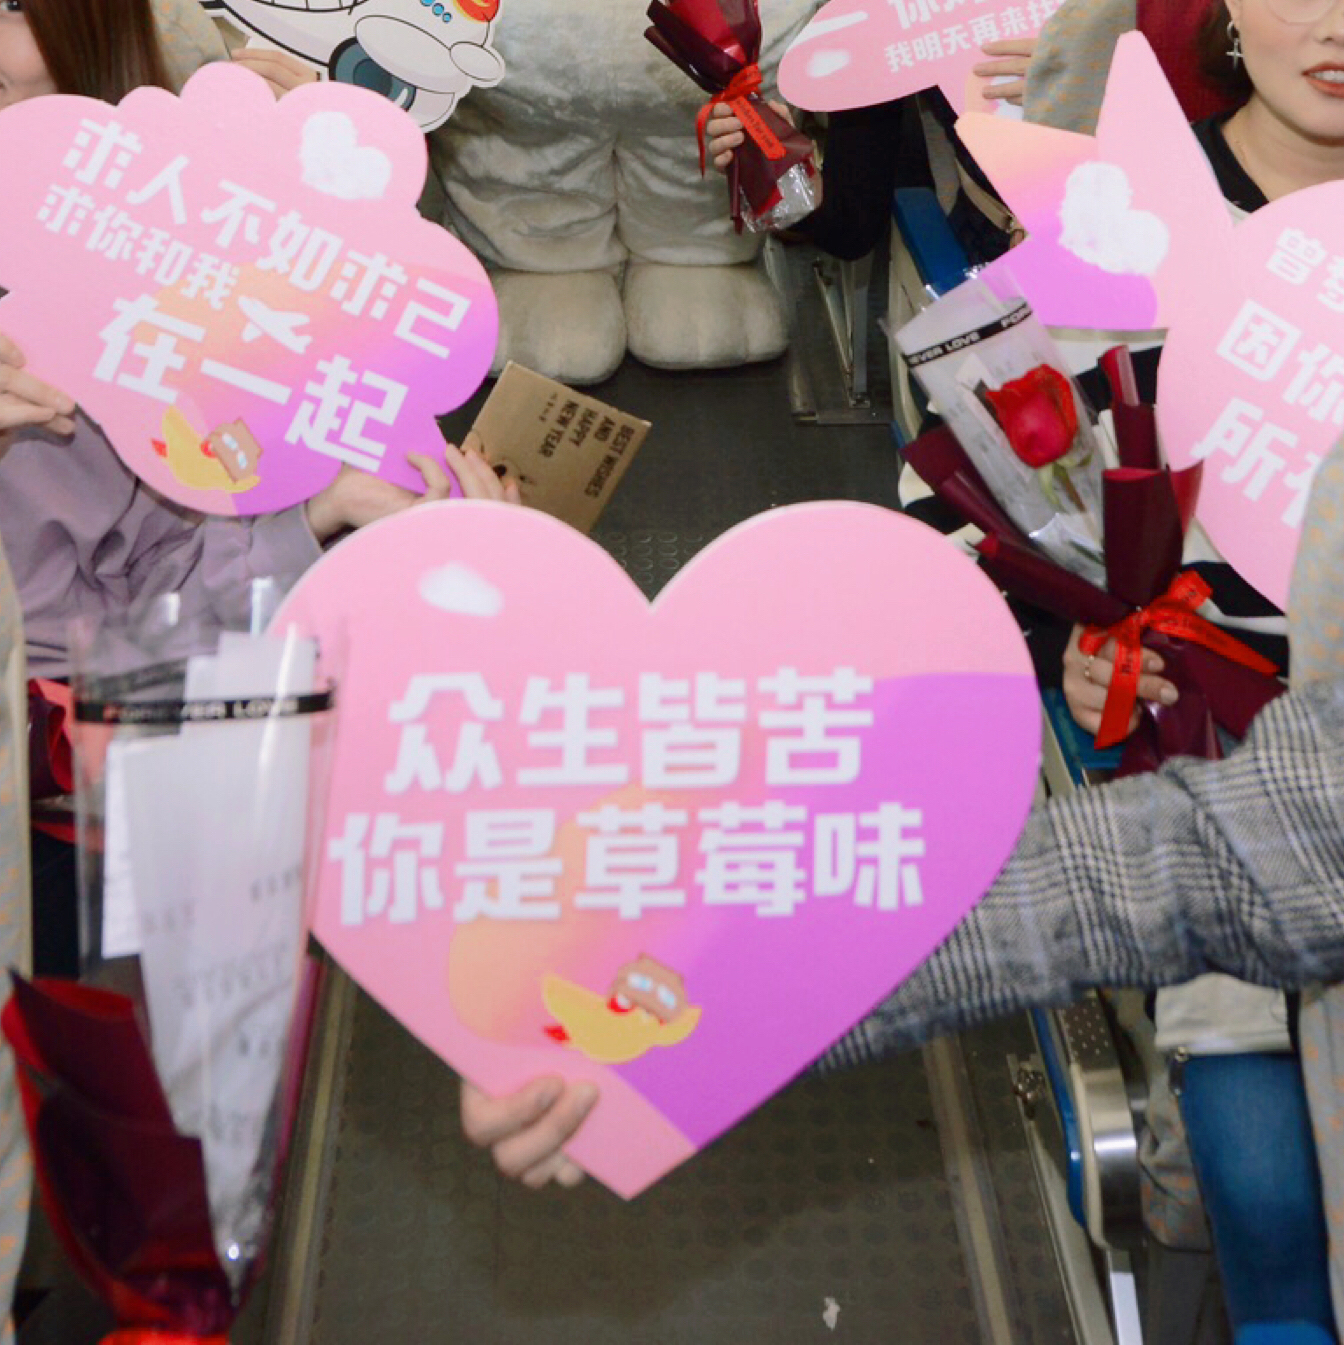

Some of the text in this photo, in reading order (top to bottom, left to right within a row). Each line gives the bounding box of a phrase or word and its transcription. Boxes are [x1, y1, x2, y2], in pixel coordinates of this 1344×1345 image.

[36, 183, 241, 312] 求你和我
[61, 117, 472, 360] 求人不如求己
[944, 330, 981, 352] LOVE
[91, 292, 410, 473] 在一起
[557, 399, 579, 428] NEW
[537, 428, 564, 458] YEAR
[568, 408, 598, 447] HAPPY
[585, 424, 635, 498] BEST WISHES
[594, 416, 615, 442] AND
[383, 665, 876, 796] 众生皆苦
[327, 802, 924, 928] 你是草莓味
